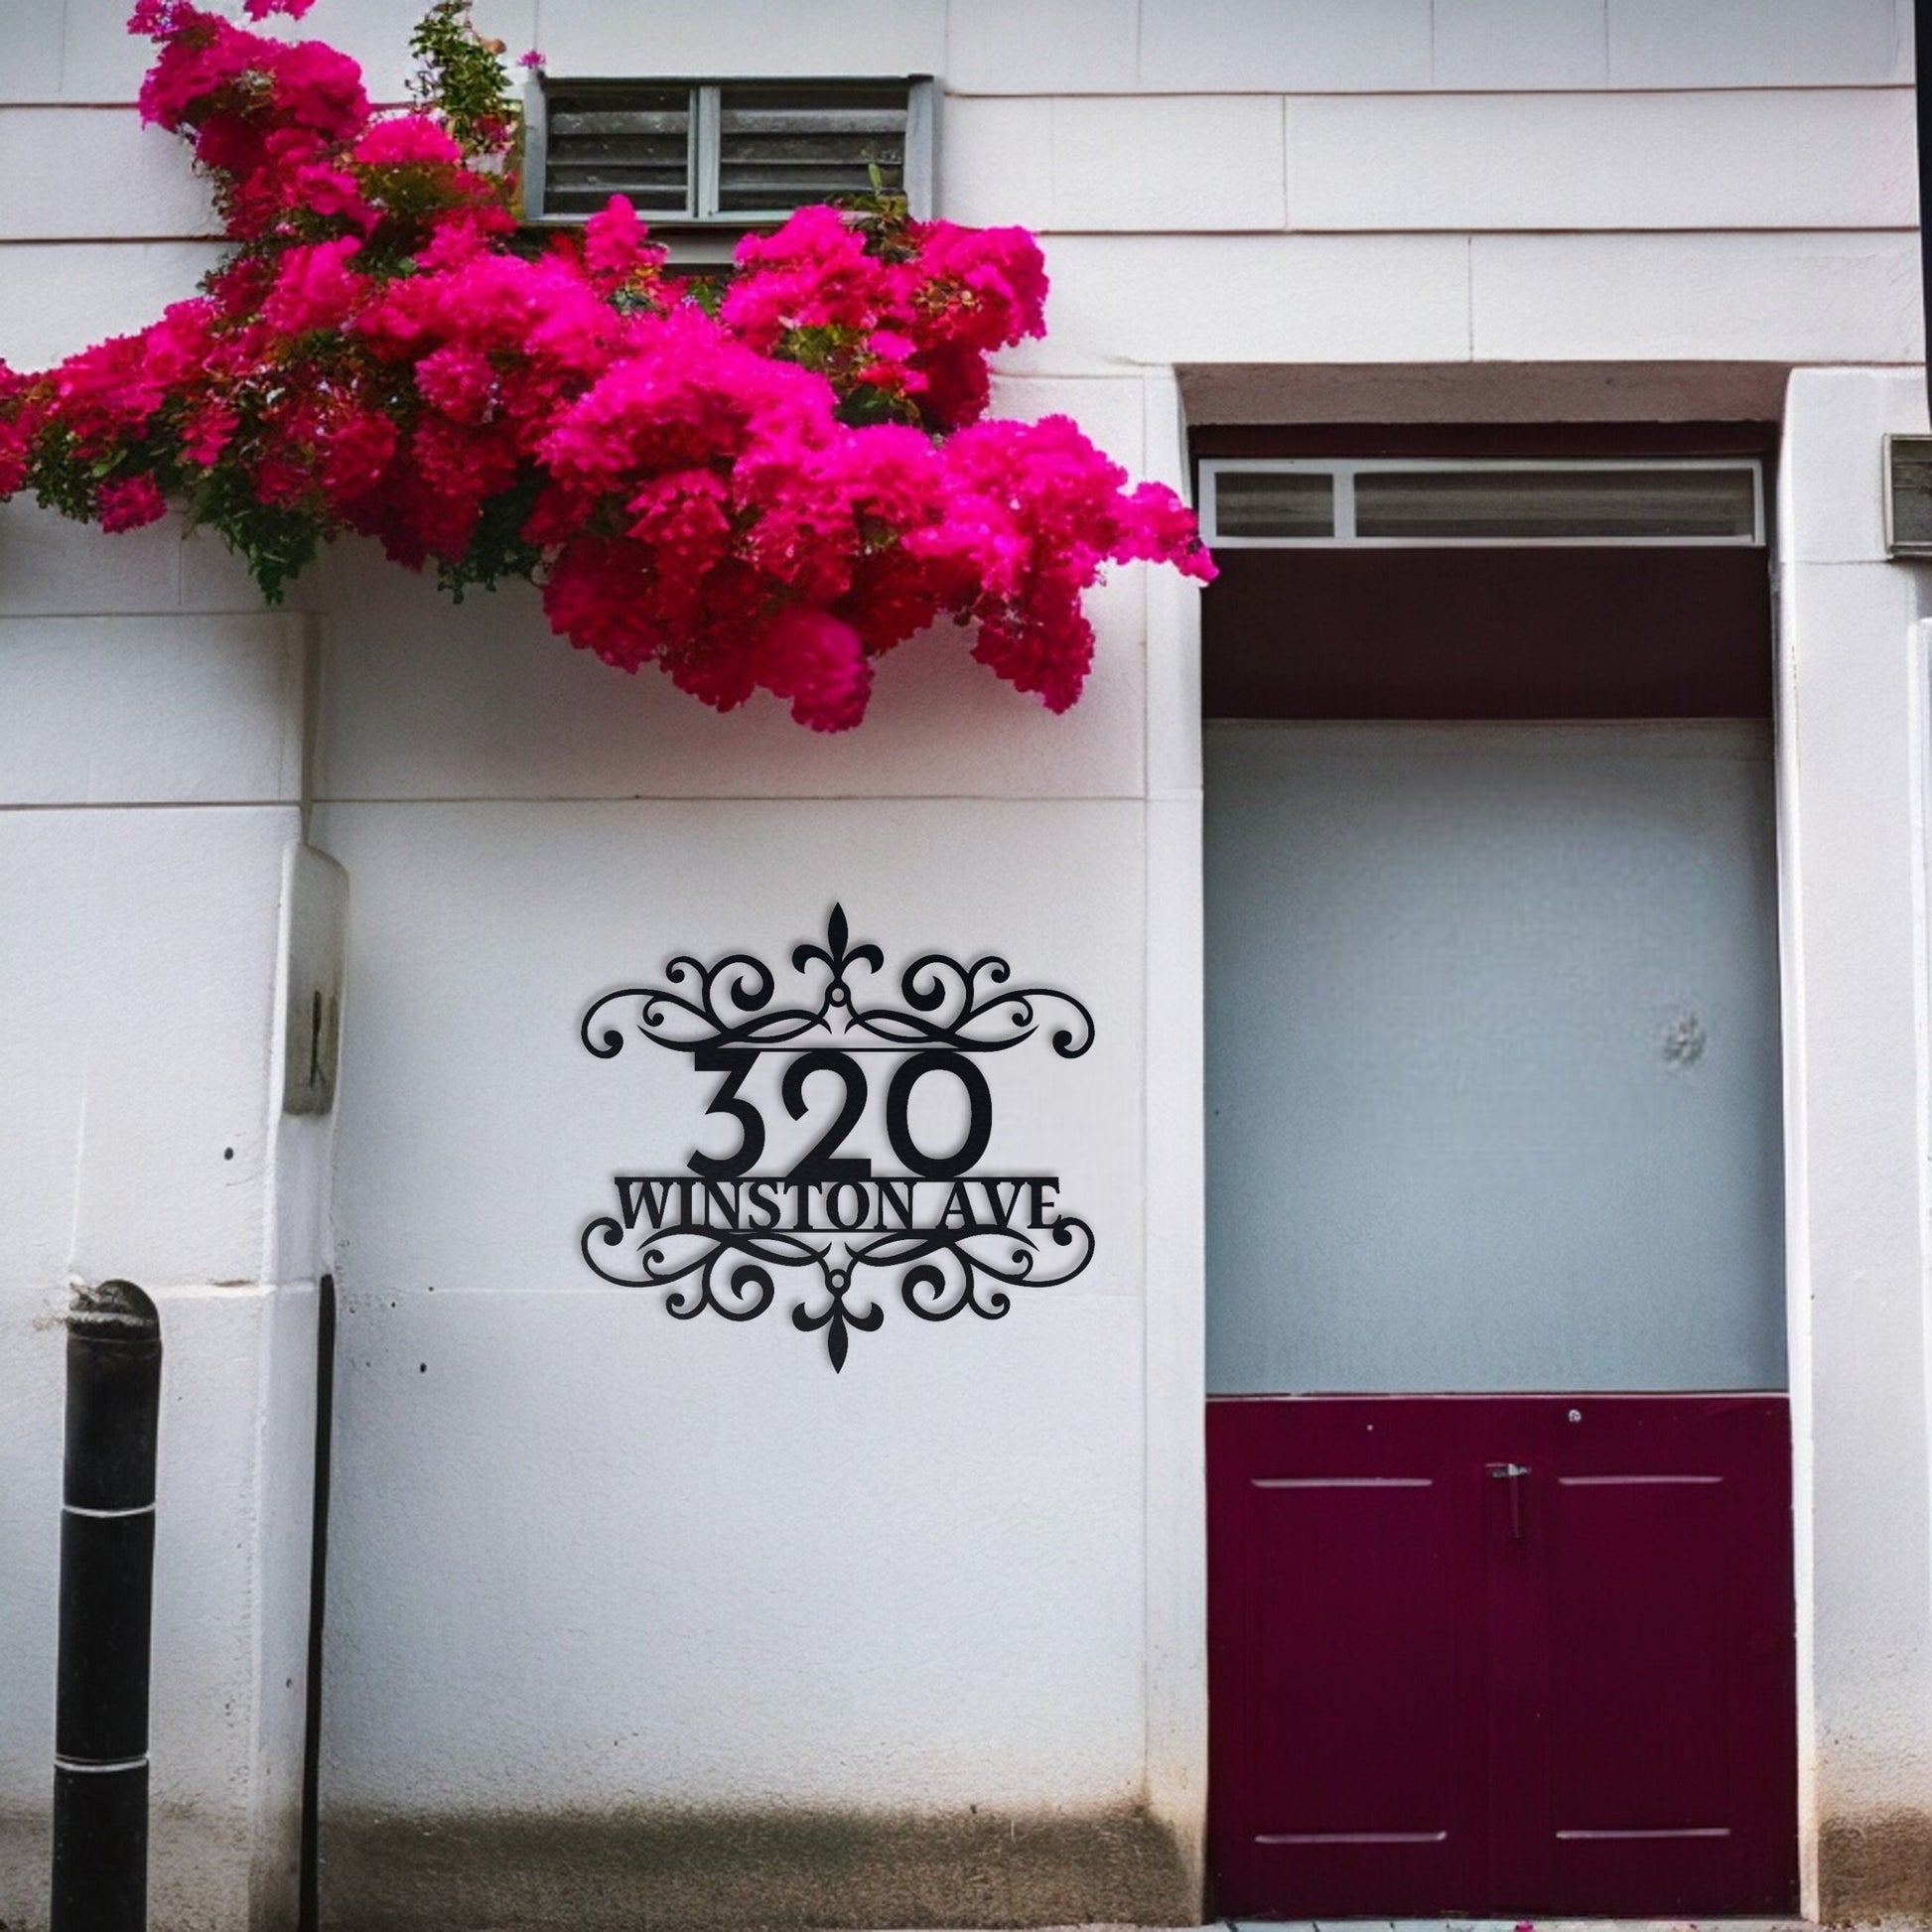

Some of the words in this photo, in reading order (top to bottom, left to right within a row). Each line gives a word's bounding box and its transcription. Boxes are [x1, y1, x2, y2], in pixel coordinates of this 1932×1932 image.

[686, 1049, 993, 1179] 320
[615, 1177, 918, 1230] WINSTON
[935, 1177, 1062, 1230] AVE
